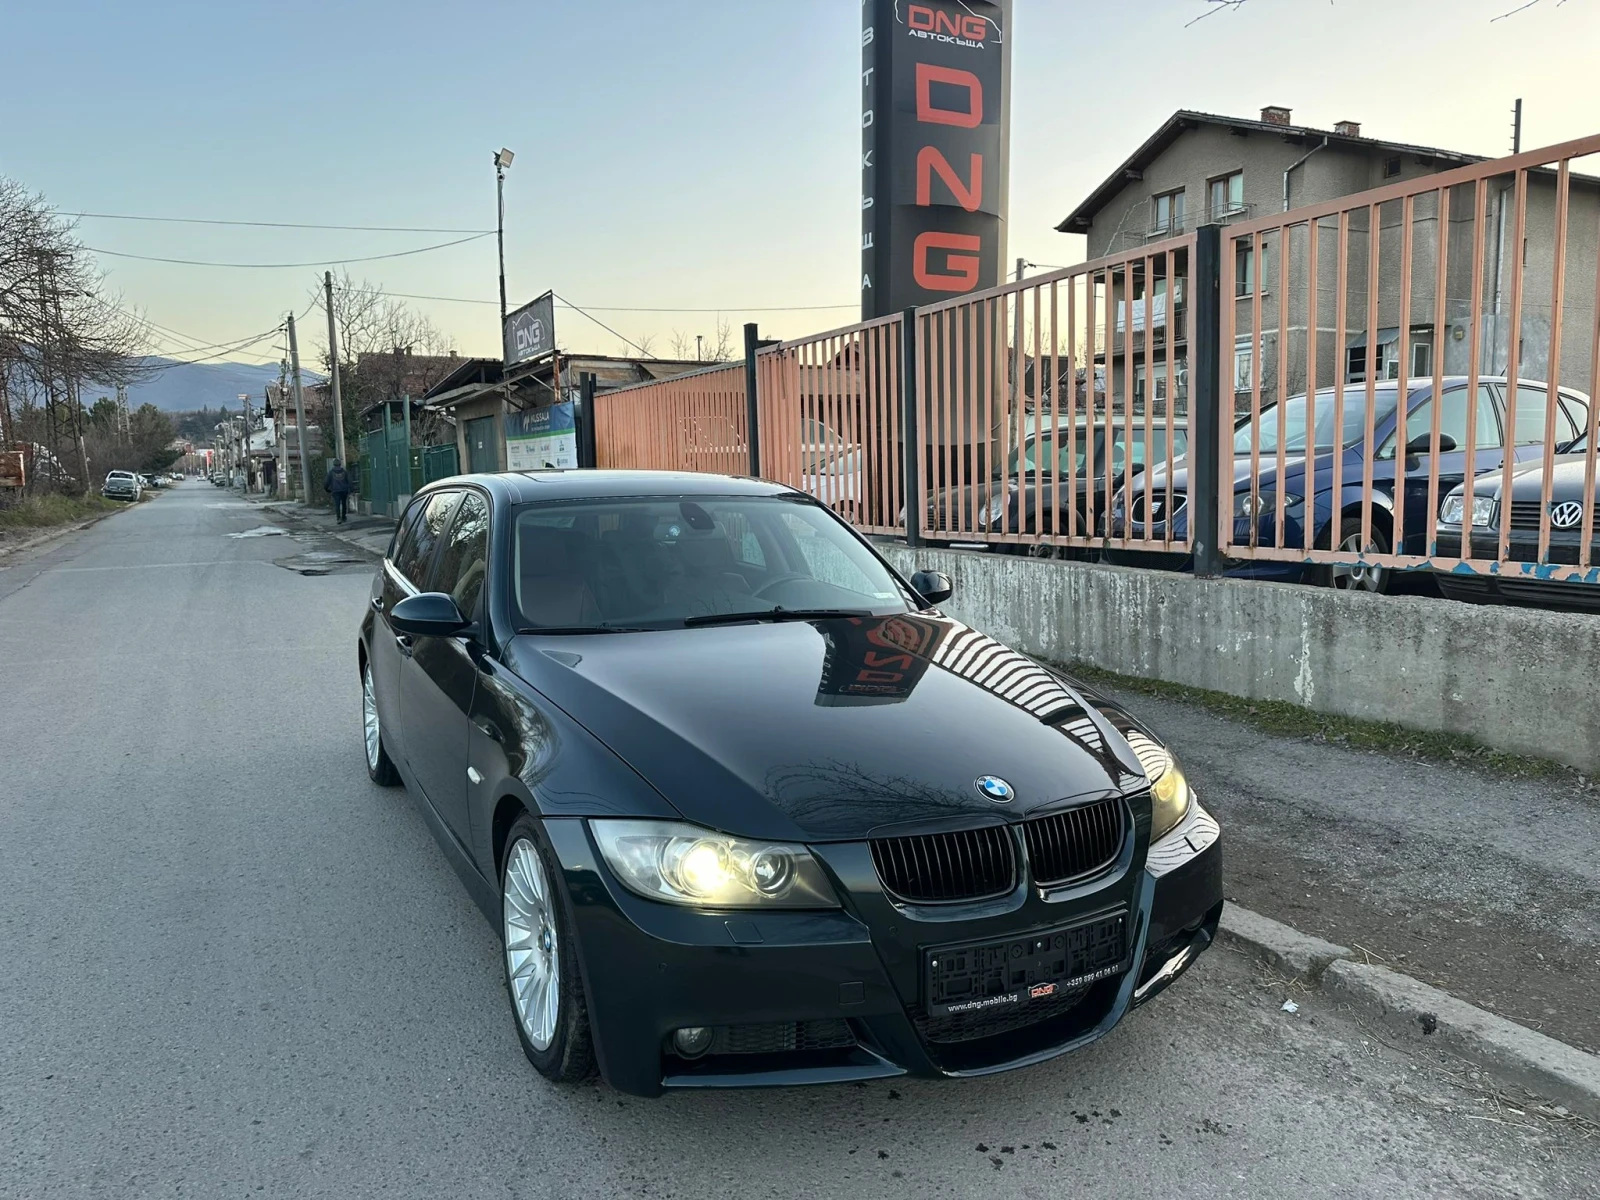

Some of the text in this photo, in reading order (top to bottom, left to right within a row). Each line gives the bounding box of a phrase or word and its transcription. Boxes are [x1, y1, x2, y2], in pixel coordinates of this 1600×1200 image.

[908, 4, 986, 41] DNG
[913, 62, 983, 292] DNG
[516, 321, 540, 350] DNG
[947, 993, 1018, 1012] www.dng.mobile.bg
